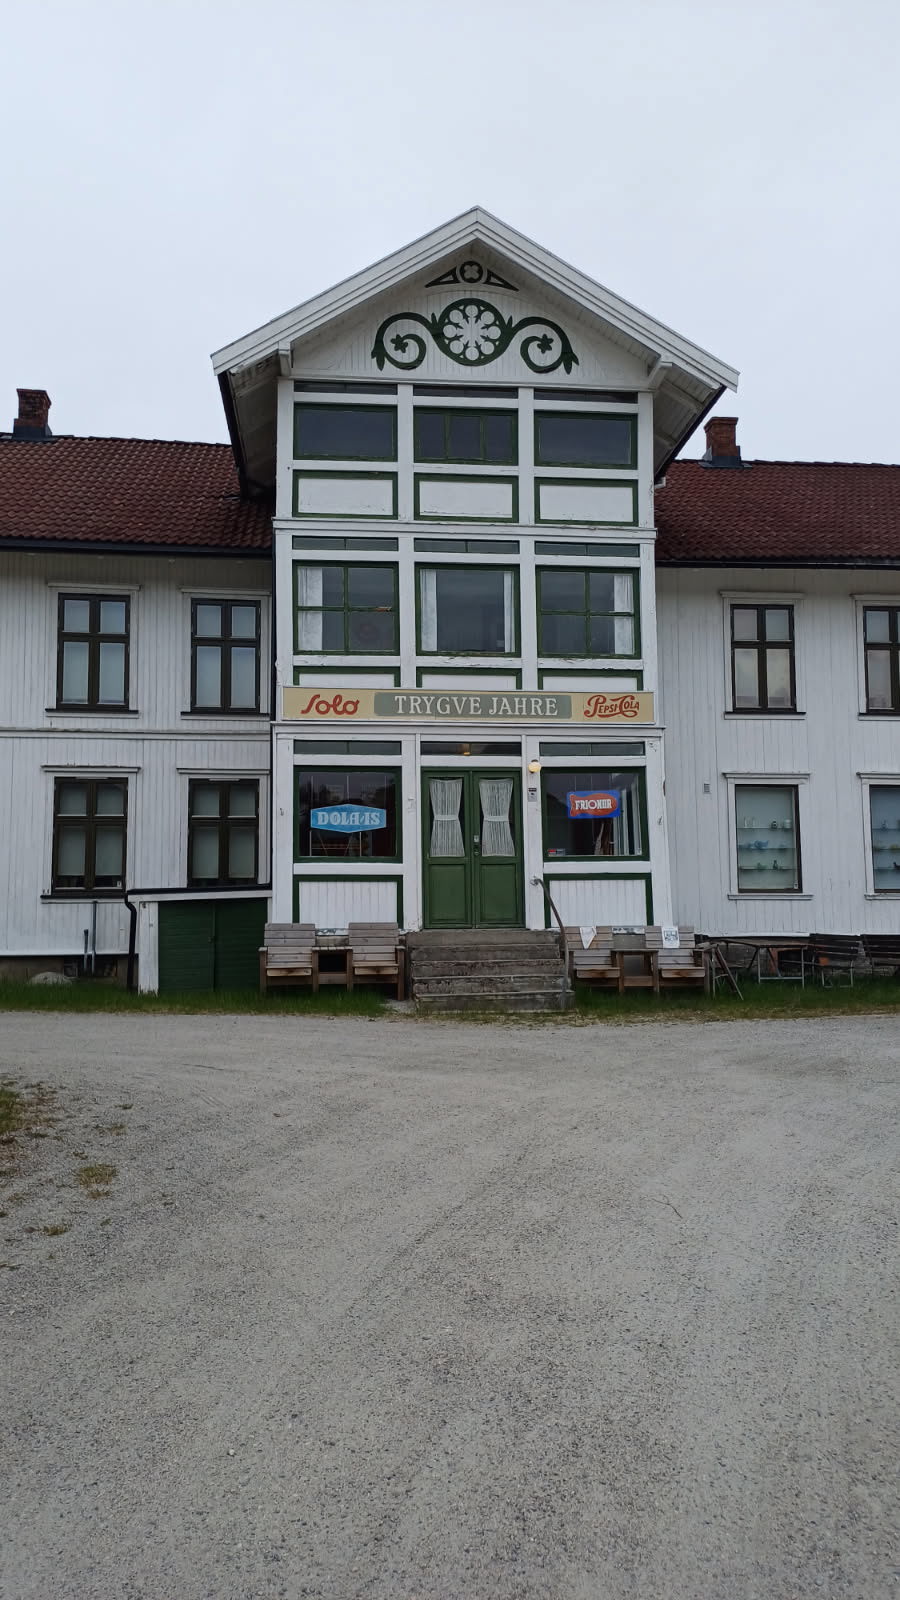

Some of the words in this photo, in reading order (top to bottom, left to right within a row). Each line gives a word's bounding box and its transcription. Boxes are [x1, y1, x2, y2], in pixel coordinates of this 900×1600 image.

[301, 694, 359, 715] Solo
[395, 696, 482, 714] TRYGVE
[489, 698, 558, 715] JAHRE
